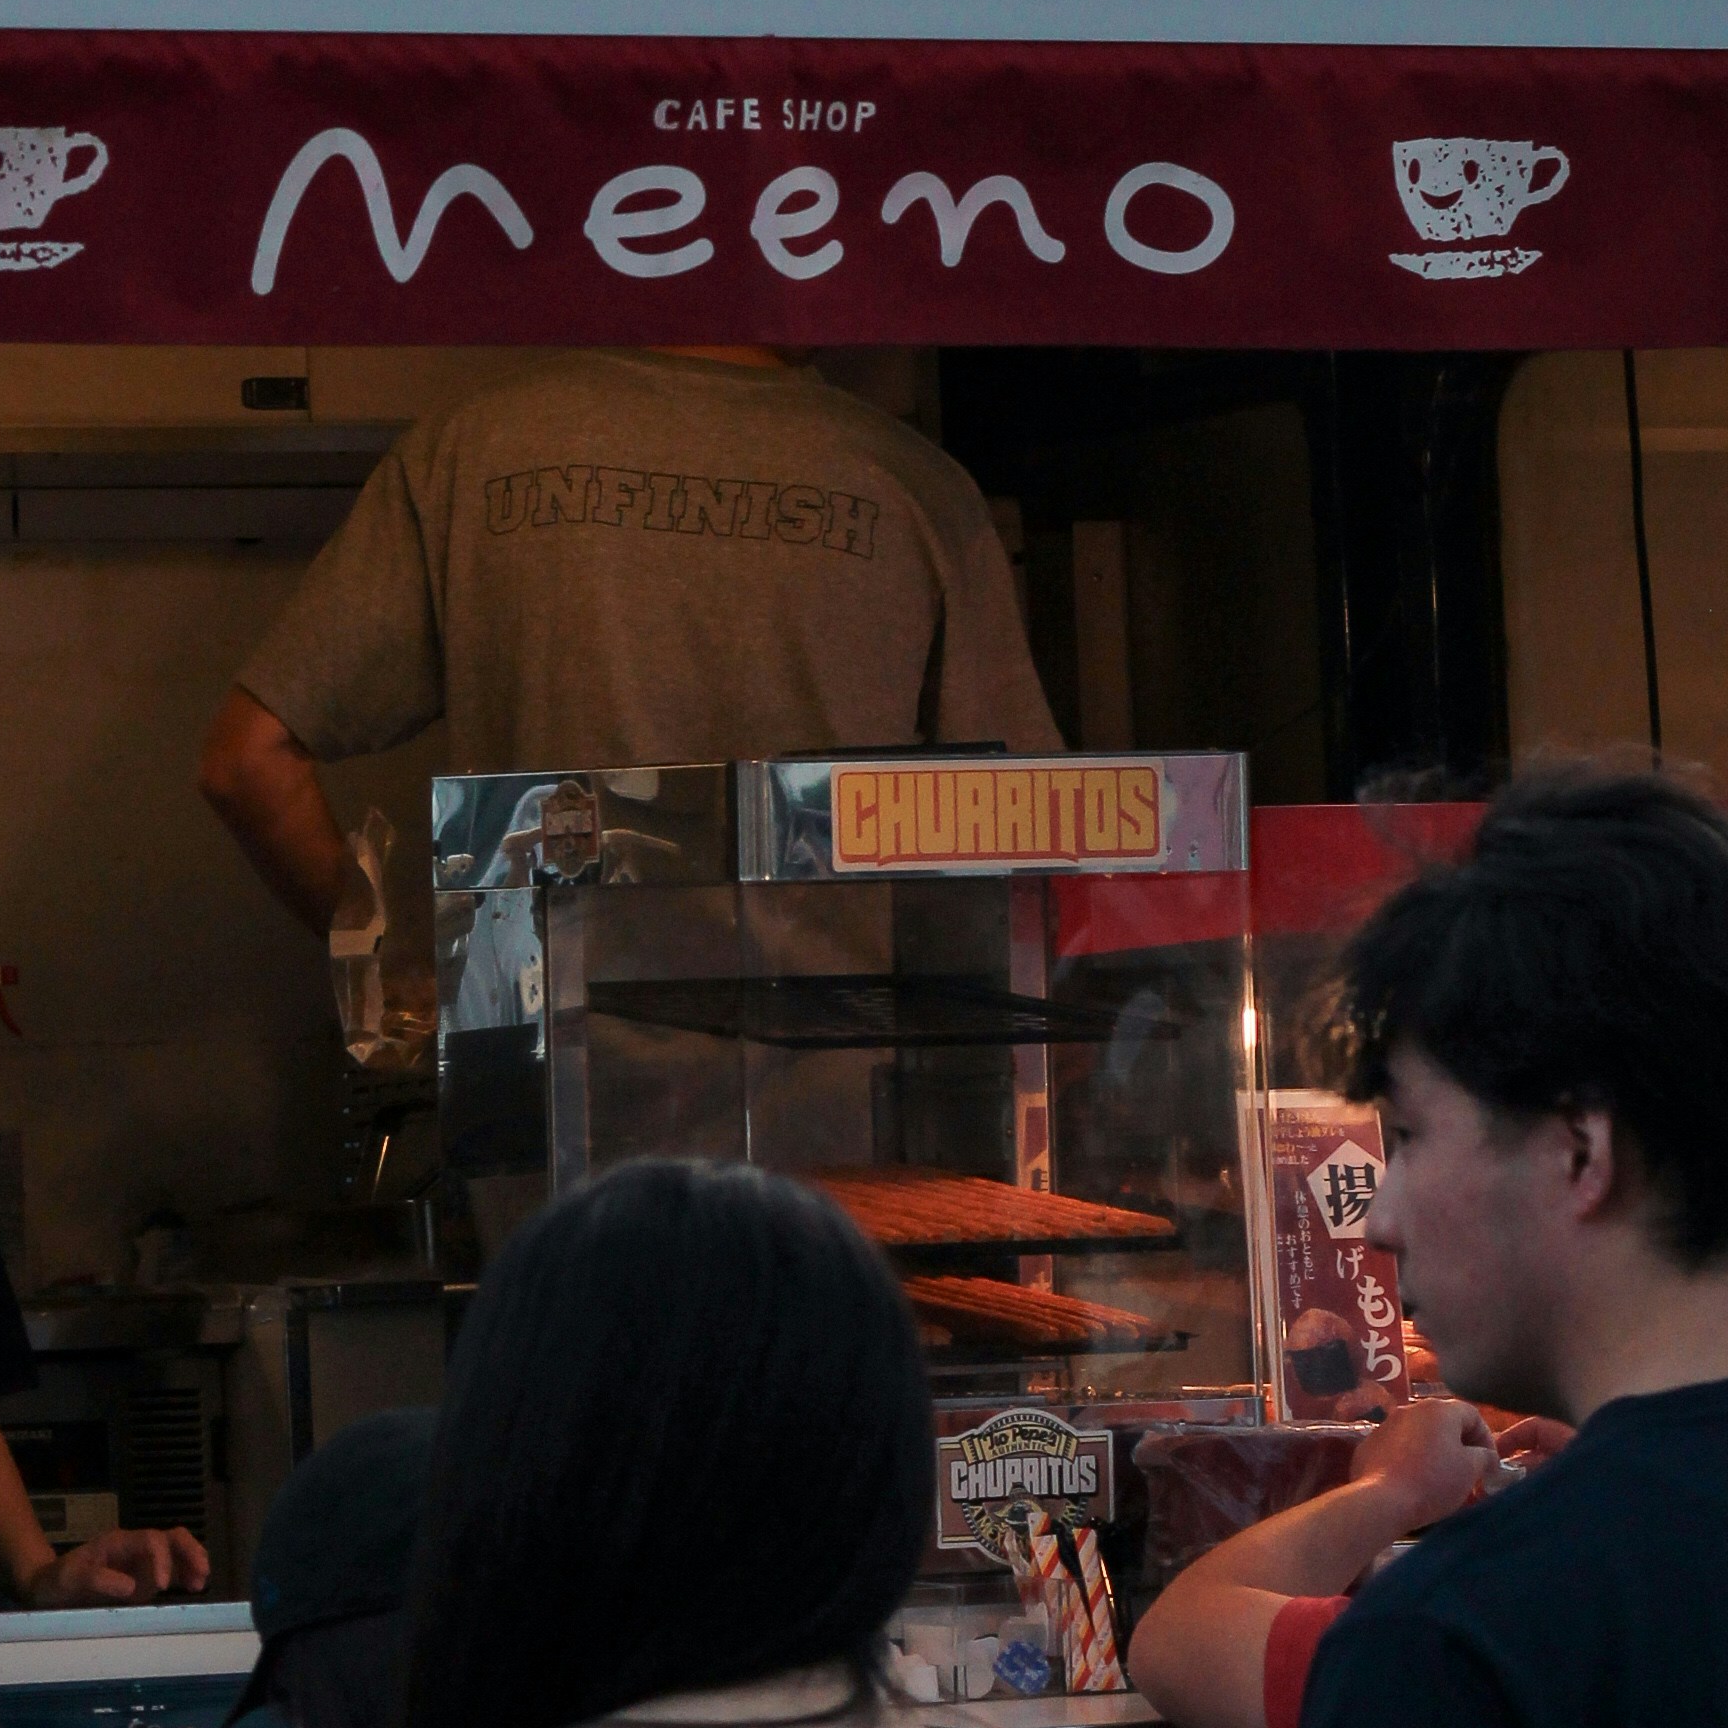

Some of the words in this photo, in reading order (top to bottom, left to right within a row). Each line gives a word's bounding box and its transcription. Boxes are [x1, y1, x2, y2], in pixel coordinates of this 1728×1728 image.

[654, 97, 764, 133] CAFE
[783, 100, 877, 135] SHOP
[250, 127, 1236, 297] Meeno
[484, 464, 879, 560] UNFINISH
[838, 771, 1159, 857] CHURRITOS
